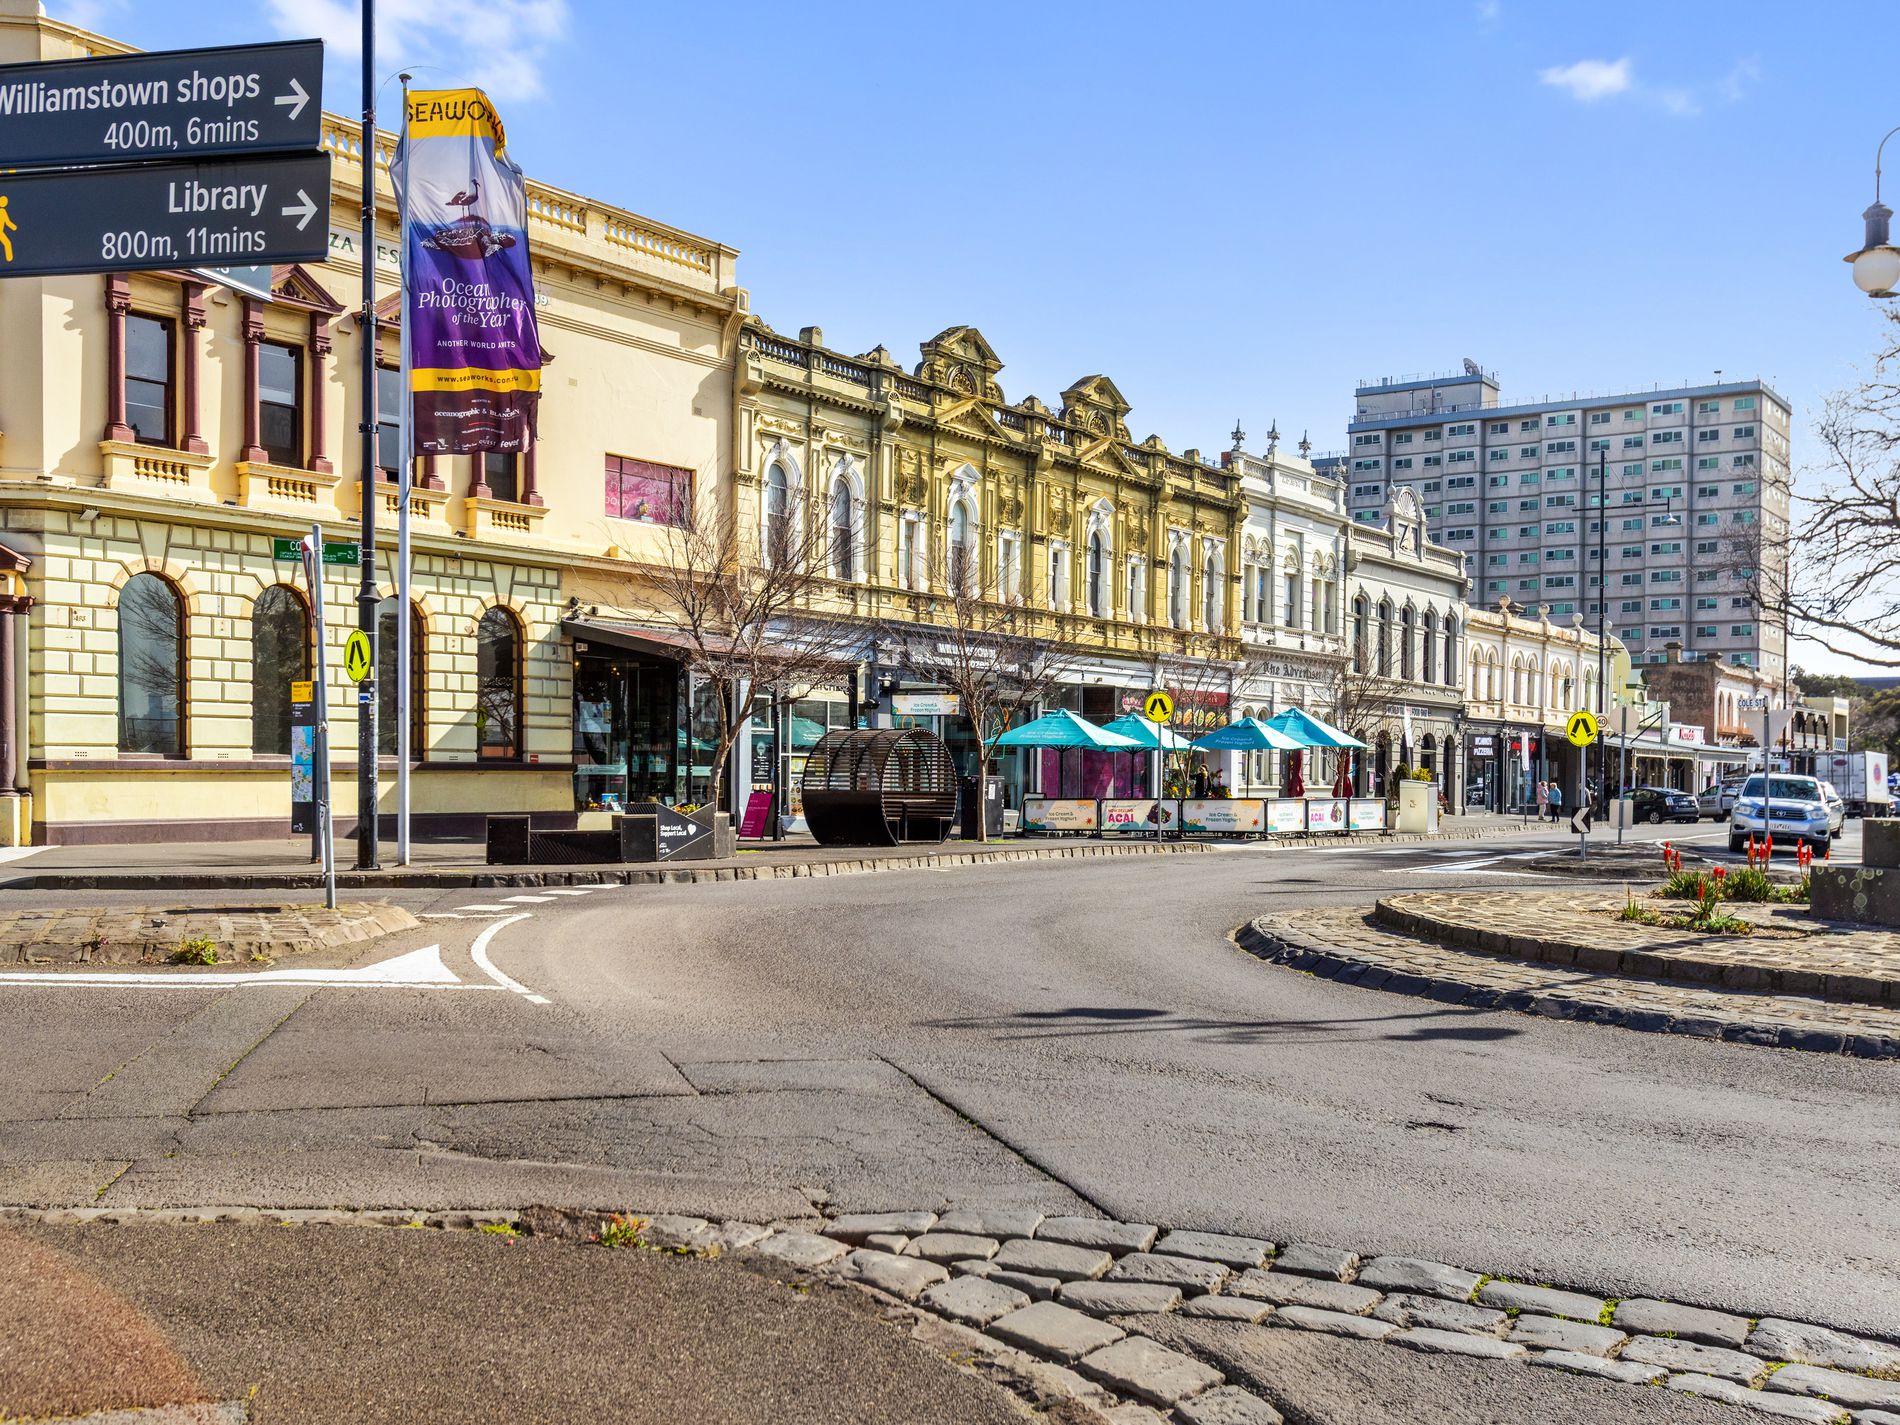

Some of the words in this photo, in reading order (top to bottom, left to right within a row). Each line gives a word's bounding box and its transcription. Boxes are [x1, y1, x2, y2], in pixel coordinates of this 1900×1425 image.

[0, 79, 168, 115] Williamstown
[177, 70, 260, 107] shops
[103, 121, 178, 150] 400m,
[186, 116, 259, 144] 6mins
[169, 180, 267, 217] Library
[102, 230, 178, 261] 800m,
[186, 226, 266, 255] 11mins
[442, 278, 491, 297] Ocean
[418, 291, 527, 313] Photographer
[451, 312, 463, 325] of
[463, 314, 479, 325] the
[479, 311, 511, 328] Year
[437, 339, 469, 348] ANOTHER
[471, 341, 496, 349] WORLD
[1737, 698, 1753, 708] COLE
[1108, 813, 1134, 823] ACAI
